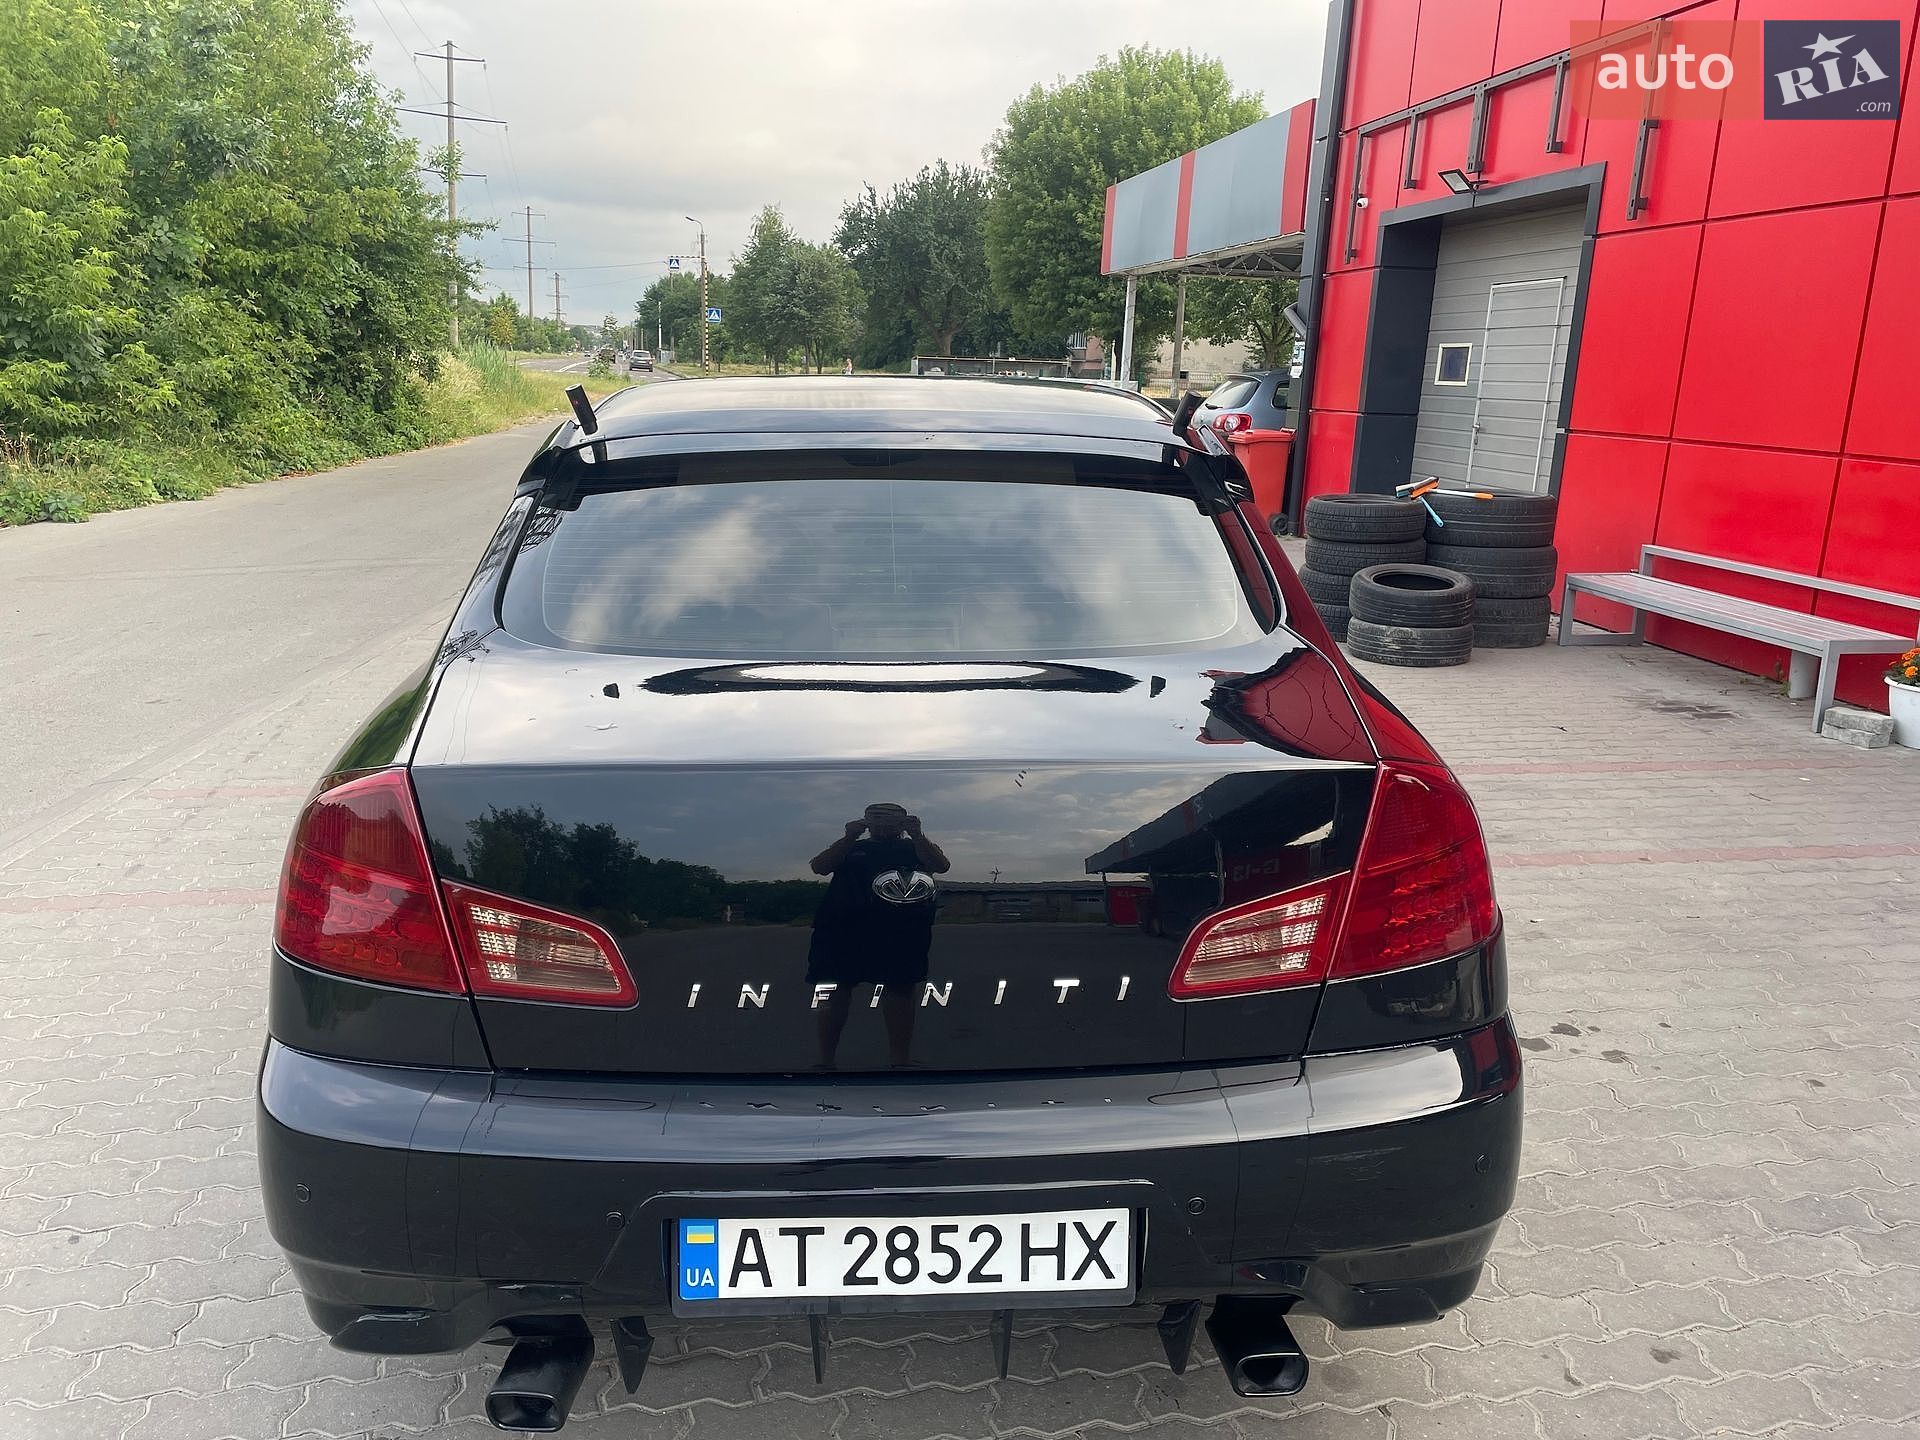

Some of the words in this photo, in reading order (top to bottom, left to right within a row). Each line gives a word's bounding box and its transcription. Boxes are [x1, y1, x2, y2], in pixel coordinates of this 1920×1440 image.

[687, 976, 1130, 1008] INFINITI
[728, 1226, 825, 1288] AT
[842, 1223, 1003, 1287] 2852
[1020, 1220, 1118, 1282] HX
[686, 1268, 716, 1288] UA
